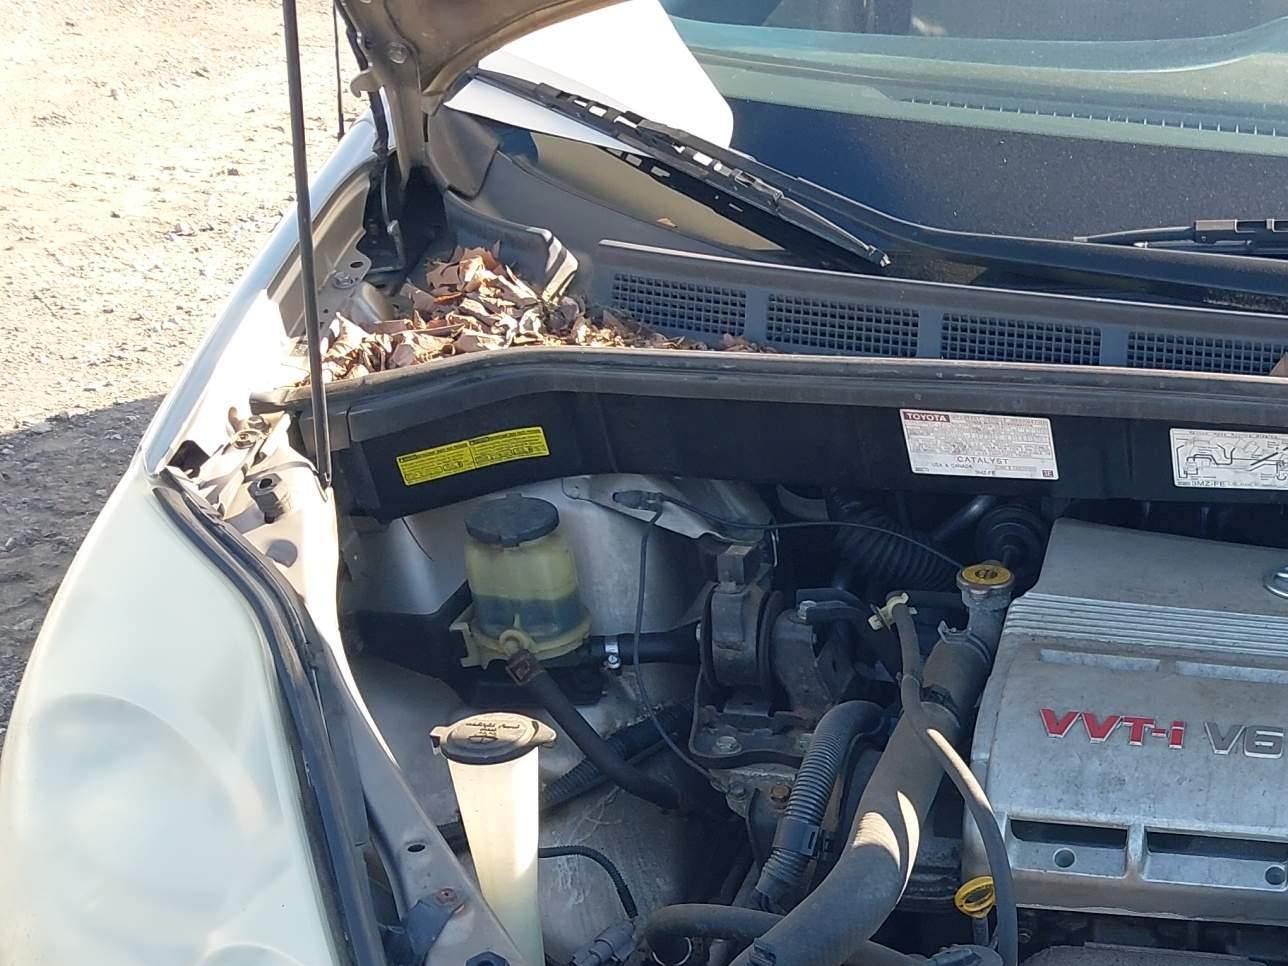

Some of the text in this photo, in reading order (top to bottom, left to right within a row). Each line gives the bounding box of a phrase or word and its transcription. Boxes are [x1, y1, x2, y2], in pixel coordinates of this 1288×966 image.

[907, 412, 948, 422] TOYOTA
[957, 456, 1010, 465] CATALYST
[1204, 721, 1285, 760] V6
